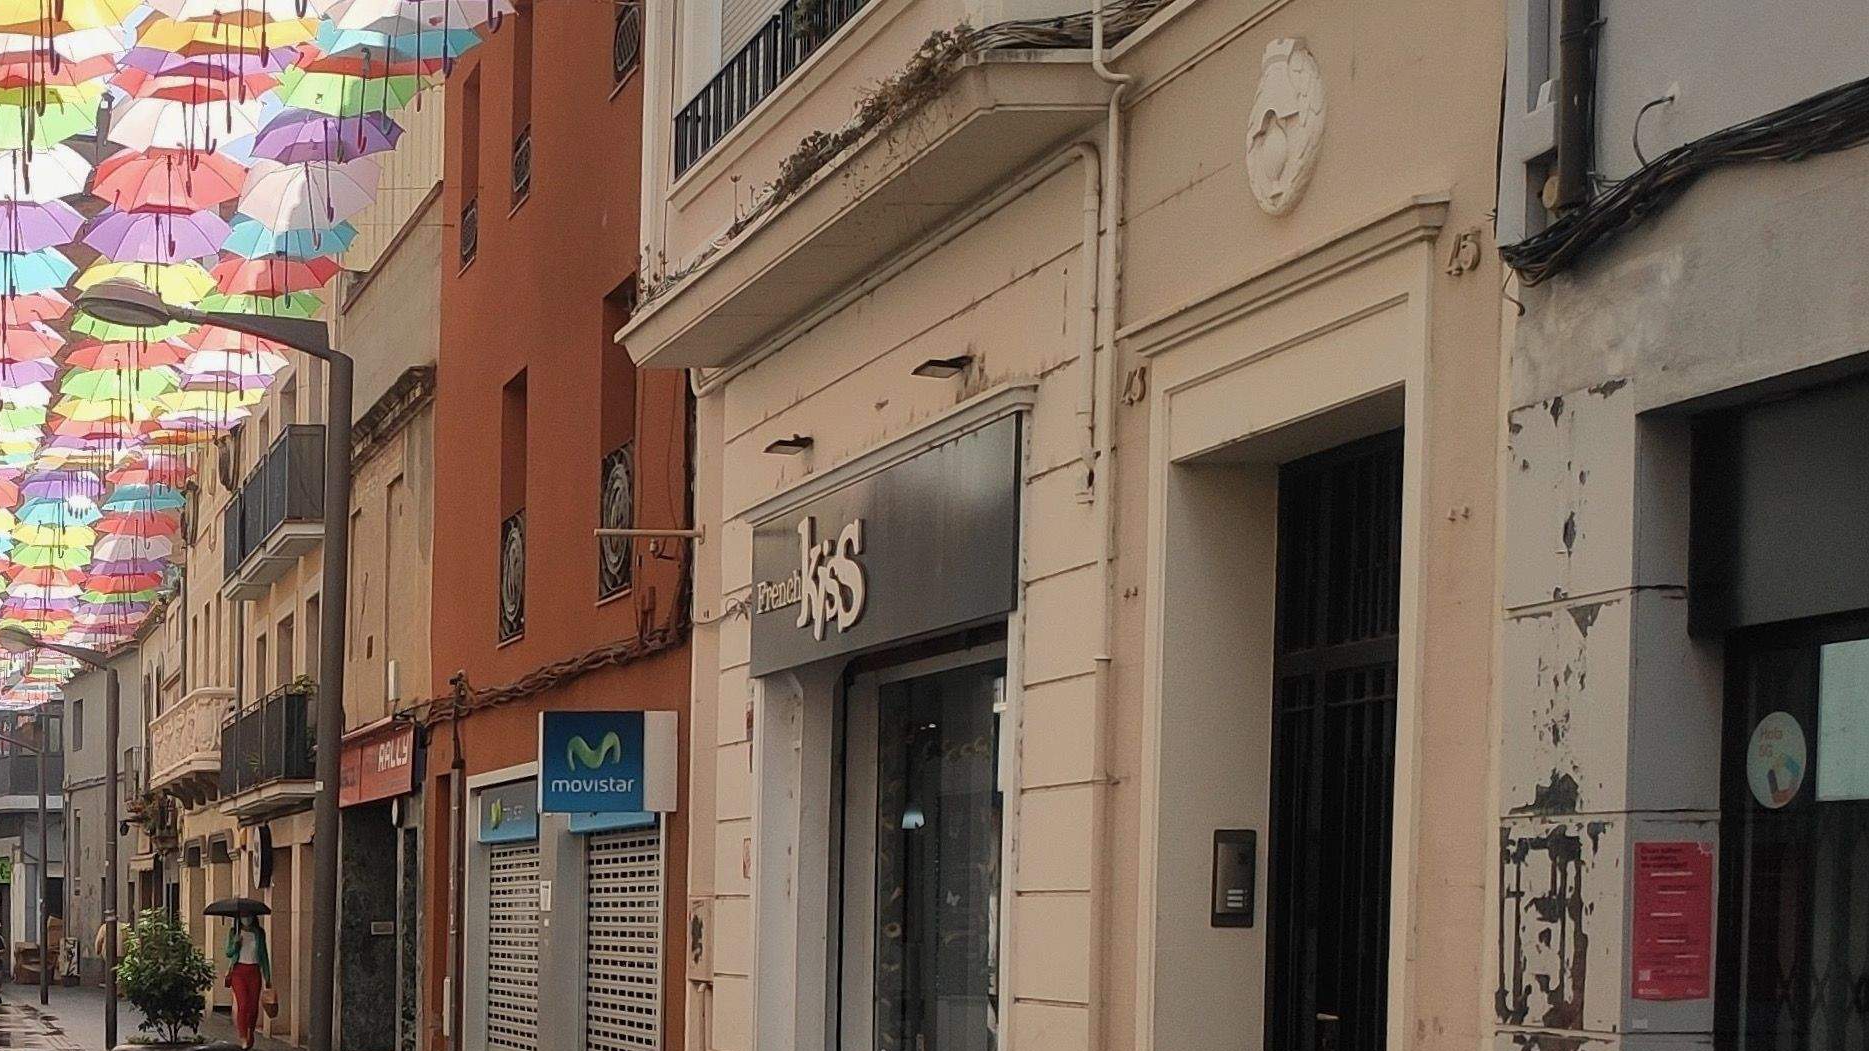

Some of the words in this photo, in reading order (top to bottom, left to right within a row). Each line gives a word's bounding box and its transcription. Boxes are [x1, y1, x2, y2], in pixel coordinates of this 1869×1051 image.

[1446, 230, 1482, 277] 45
[1120, 366, 1146, 407] 43
[755, 567, 802, 614] French
[551, 776, 635, 793] movistar
